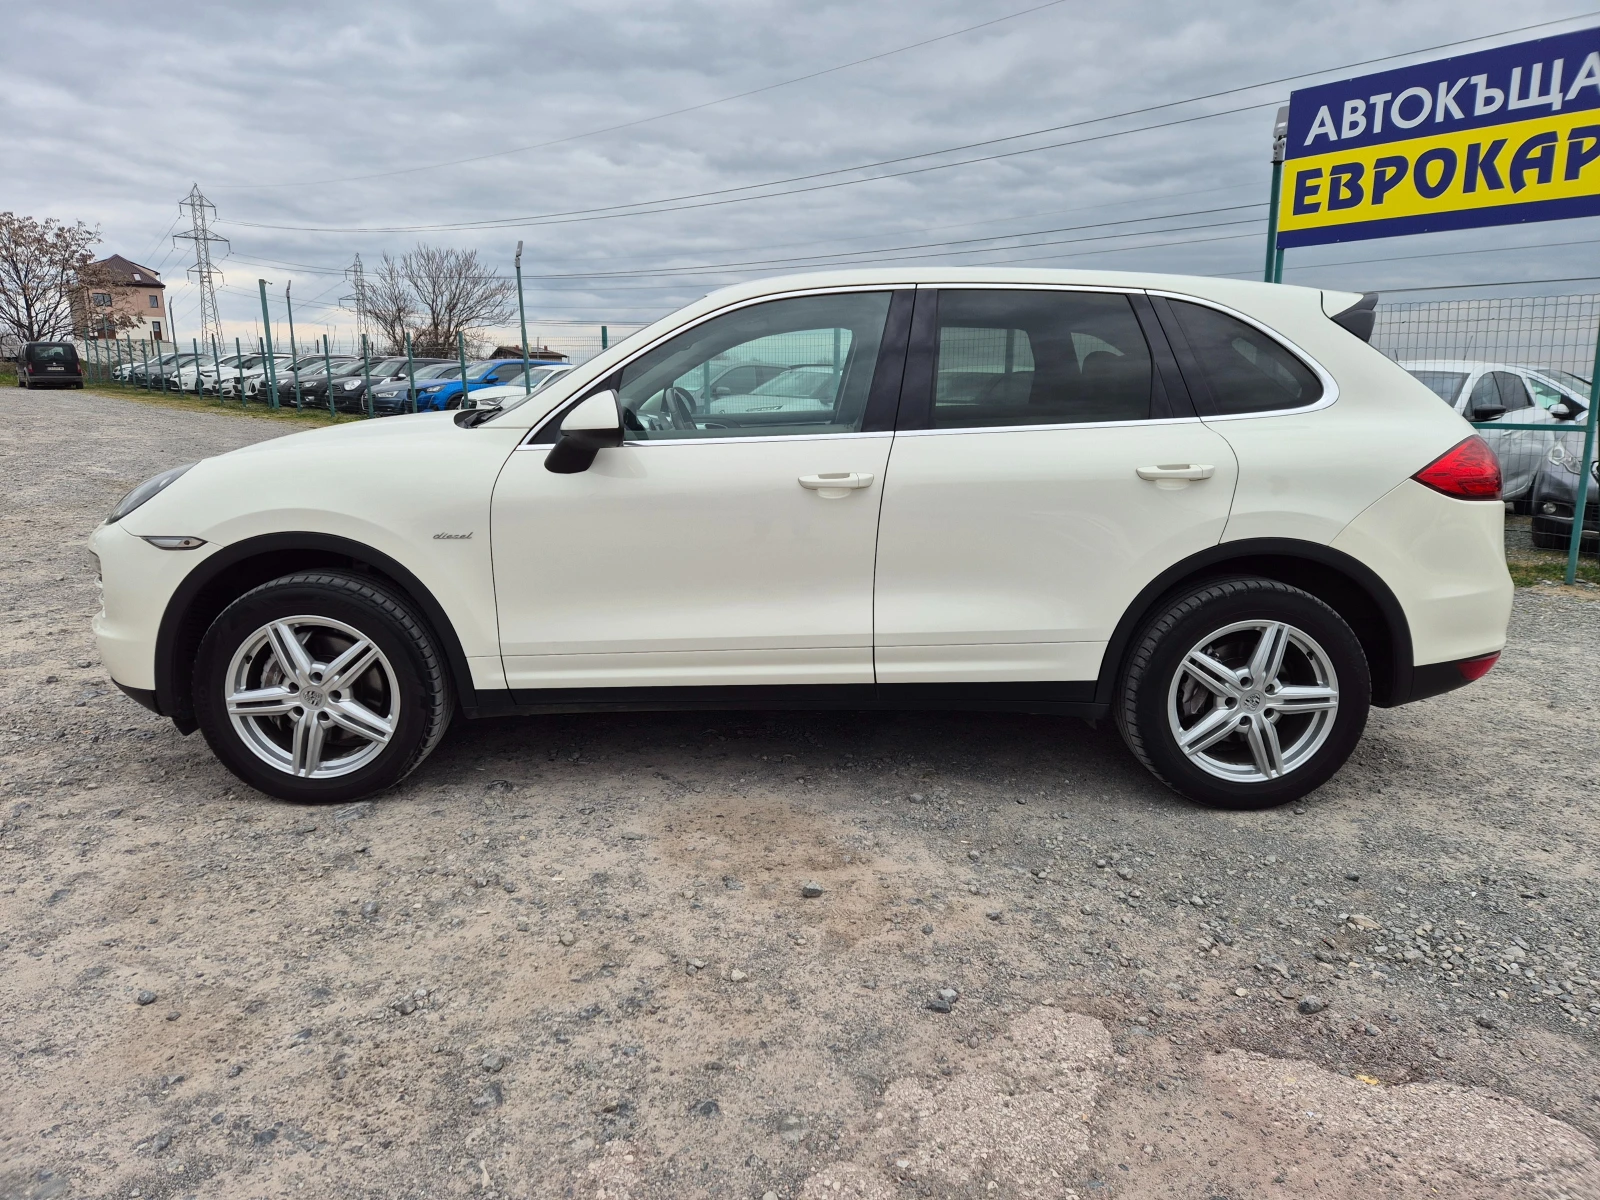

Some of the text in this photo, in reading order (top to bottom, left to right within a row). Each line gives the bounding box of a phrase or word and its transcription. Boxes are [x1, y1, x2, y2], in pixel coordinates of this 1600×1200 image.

[1303, 51, 1600, 146] АВТОКЪЩА
[1292, 124, 1600, 216] ЕВРОКАР
[432, 531, 474, 540] diesel
